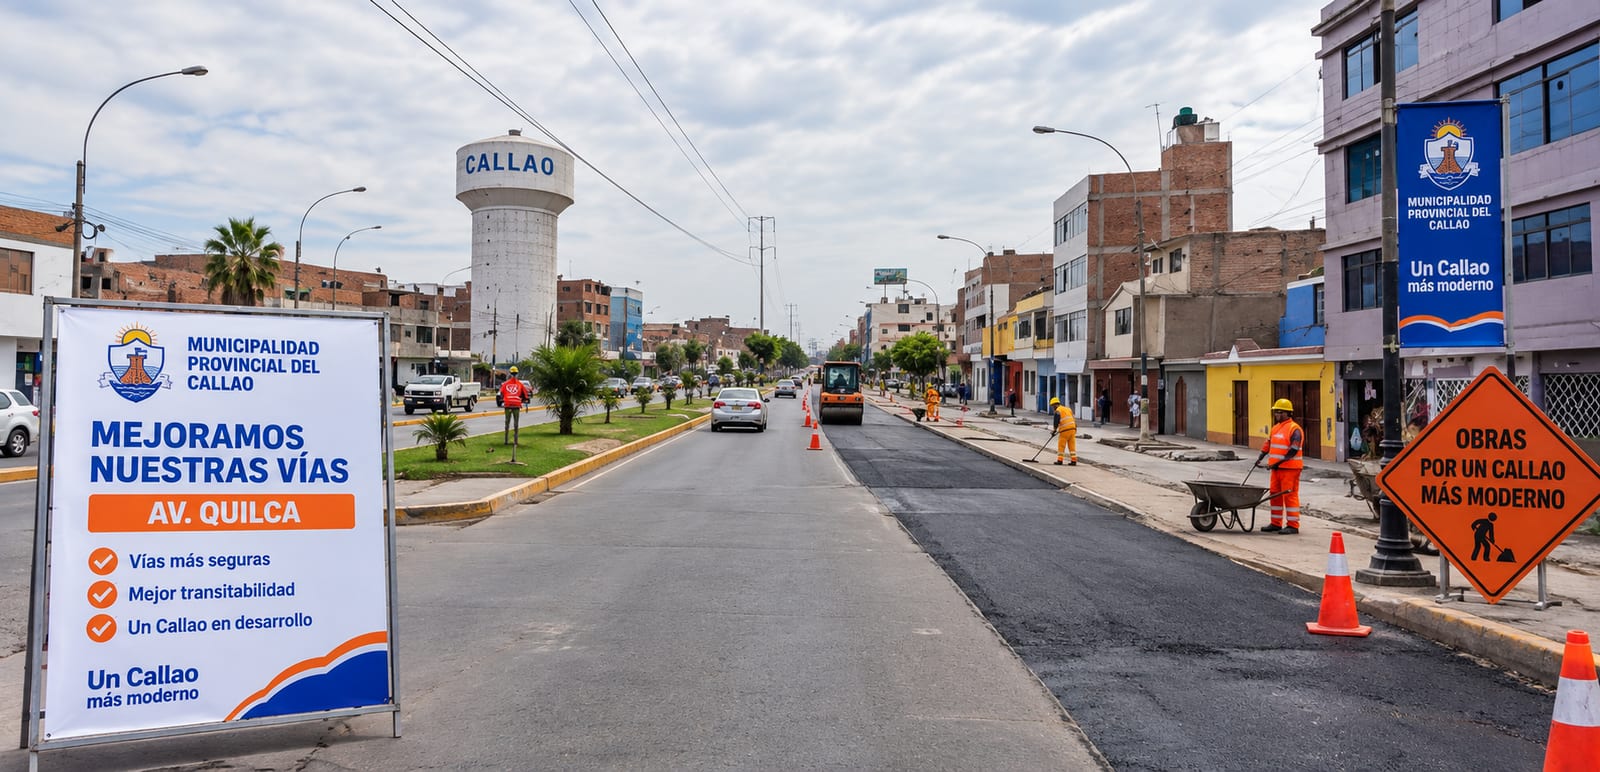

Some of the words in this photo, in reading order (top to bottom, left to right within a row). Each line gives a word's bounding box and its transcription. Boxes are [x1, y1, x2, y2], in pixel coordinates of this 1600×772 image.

[465, 152, 554, 176] CALLAO
[1408, 195, 1492, 207] MUNICIPALIDAD
[1408, 207, 1470, 219] PROVINCIAL
[1472, 207, 1491, 217] DEL
[1429, 219, 1470, 230] CALLAO
[1411, 260, 1433, 277] Un
[1437, 259, 1490, 276] Callao
[1408, 279, 1434, 292] más
[1437, 278, 1494, 292] moderno
[187, 336, 320, 356] MUNICIPALIDAD
[187, 355, 287, 374] PROVINCIAL
[290, 358, 321, 375] DEL
[187, 374, 254, 392] CALLAO
[91, 420, 305, 451] MEJORAMOS
[1455, 427, 1527, 451] OBRAS
[90, 455, 269, 484] NUESTRAS
[276, 450, 349, 484] VÍAS
[1420, 457, 1457, 478] POR
[1461, 458, 1487, 479] UN
[1491, 459, 1566, 481] CALLAO
[1421, 480, 1463, 507] MÁS
[1467, 486, 1566, 510] MODERNO
[147, 501, 192, 525] AV.
[199, 500, 301, 525] QUILCA
[128, 552, 166, 569] Vías
[169, 552, 205, 569] más
[208, 554, 271, 571] seguras
[128, 585, 177, 605] Mejor
[179, 581, 296, 601] transitabilidad
[127, 619, 152, 636] Un
[155, 616, 208, 635] Callao
[211, 618, 231, 632] en
[234, 611, 313, 630] desarrollo
[87, 669, 122, 691] Un
[126, 664, 199, 688] Callao
[86, 691, 123, 710] más
[126, 687, 200, 706] moderno
